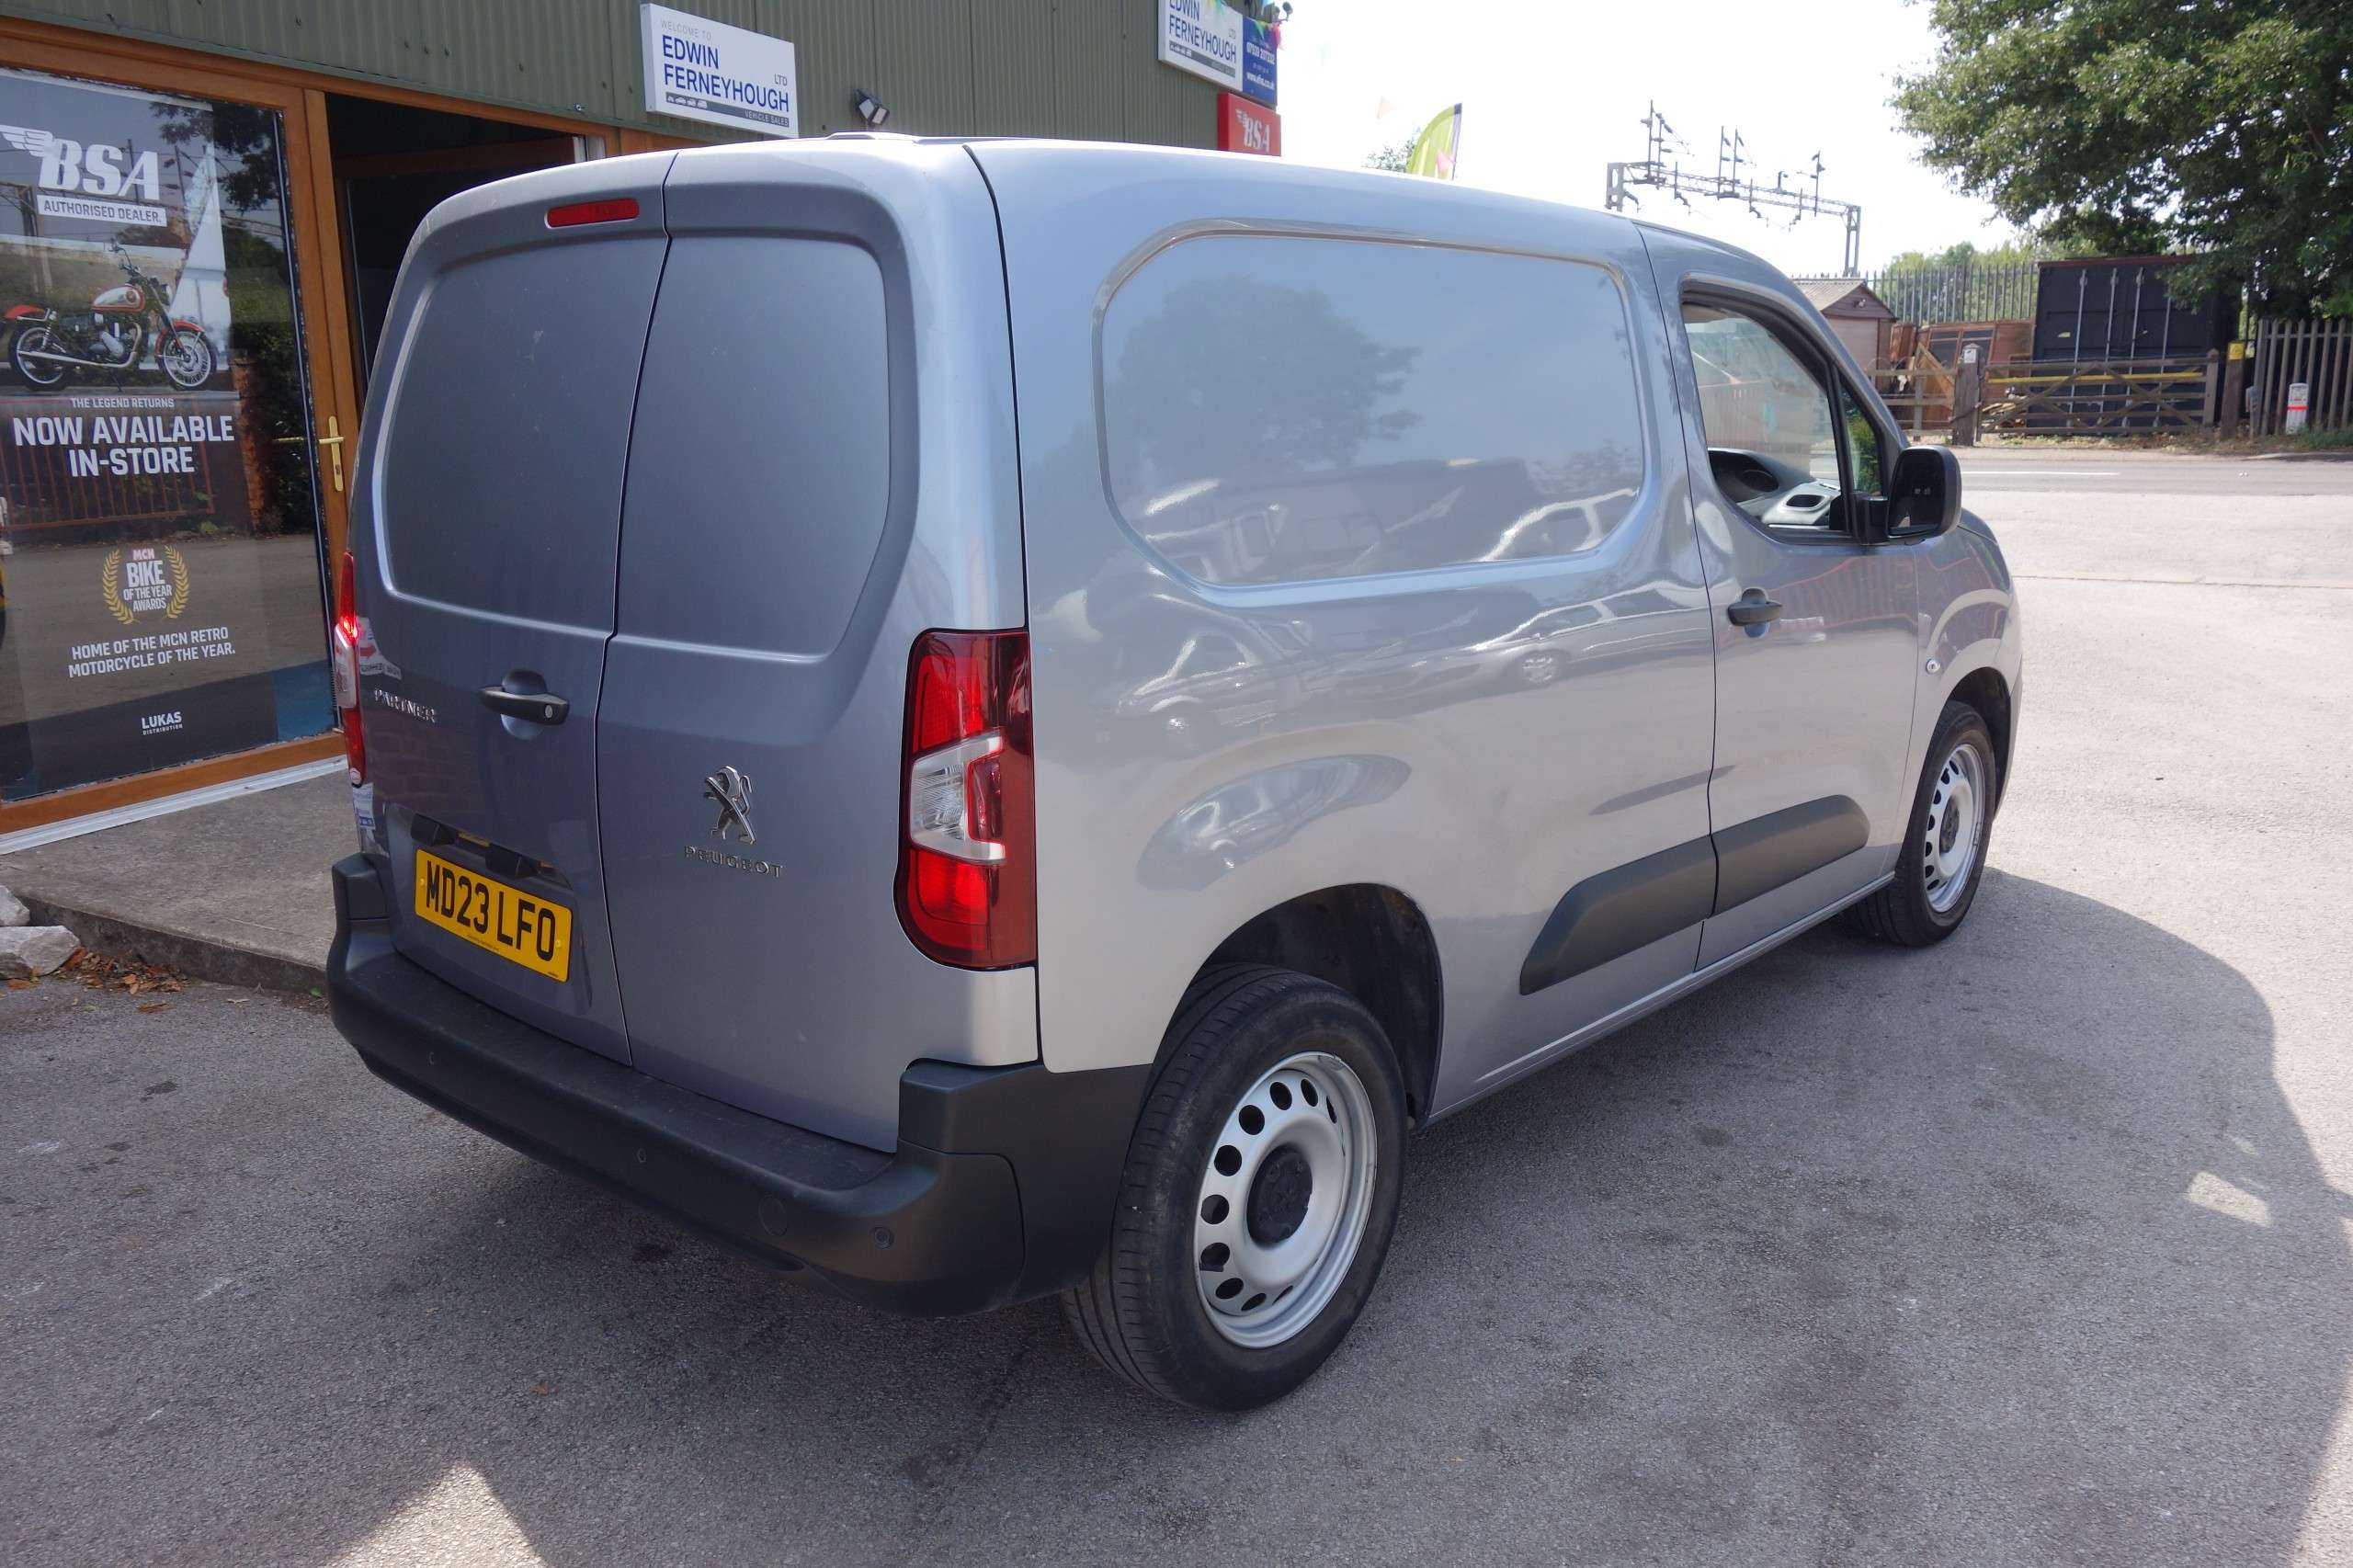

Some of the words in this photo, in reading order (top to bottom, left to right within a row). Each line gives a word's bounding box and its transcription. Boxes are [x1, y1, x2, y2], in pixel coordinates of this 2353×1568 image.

[661, 18, 699, 37] WELCOME
[702, 29, 711, 41] TO
[1169, 14, 1236, 63] FERNEYHOUGH
[662, 34, 719, 70] EDWIN
[664, 63, 789, 112] FERNEYHOUGH
[774, 73, 788, 86] LTD
[745, 109, 769, 123] VEHICLE
[770, 115, 789, 127] SALES
[1243, 116, 1269, 153] BSA
[39, 138, 160, 200] BSA
[44, 199, 115, 219] AUTHORISED
[118, 207, 162, 222] DEALER.
[72, 397, 90, 408] THE
[93, 398, 130, 408] LEGEND
[131, 398, 175, 408] RETURNS
[13, 416, 83, 446] NOW
[93, 415, 235, 444] AVAILABLE
[69, 446, 195, 477] IN-STORE
[132, 548, 155, 561] MCN
[126, 560, 165, 588] BIKE
[123, 588, 134, 601] OF
[134, 586, 152, 600] THE
[152, 585, 173, 597] YEAR
[133, 597, 166, 612] AWARDS
[72, 642, 111, 660] HOME
[113, 640, 131, 654] OF
[132, 636, 157, 652] THE
[159, 631, 188, 648] MCN
[190, 627, 229, 643] RETRO
[68, 653, 154, 678] MOTORCYCLE
[157, 651, 174, 665] OF
[176, 647, 199, 662] THE
[200, 642, 236, 658] YEAR.
[142, 711, 182, 730] LUKAS
[374, 688, 436, 723] PARTNER
[142, 723, 183, 735] DISTRIBUTION
[685, 846, 782, 877] PEUGEOT
[426, 860, 489, 934] MD23
[496, 891, 556, 962] LFO
